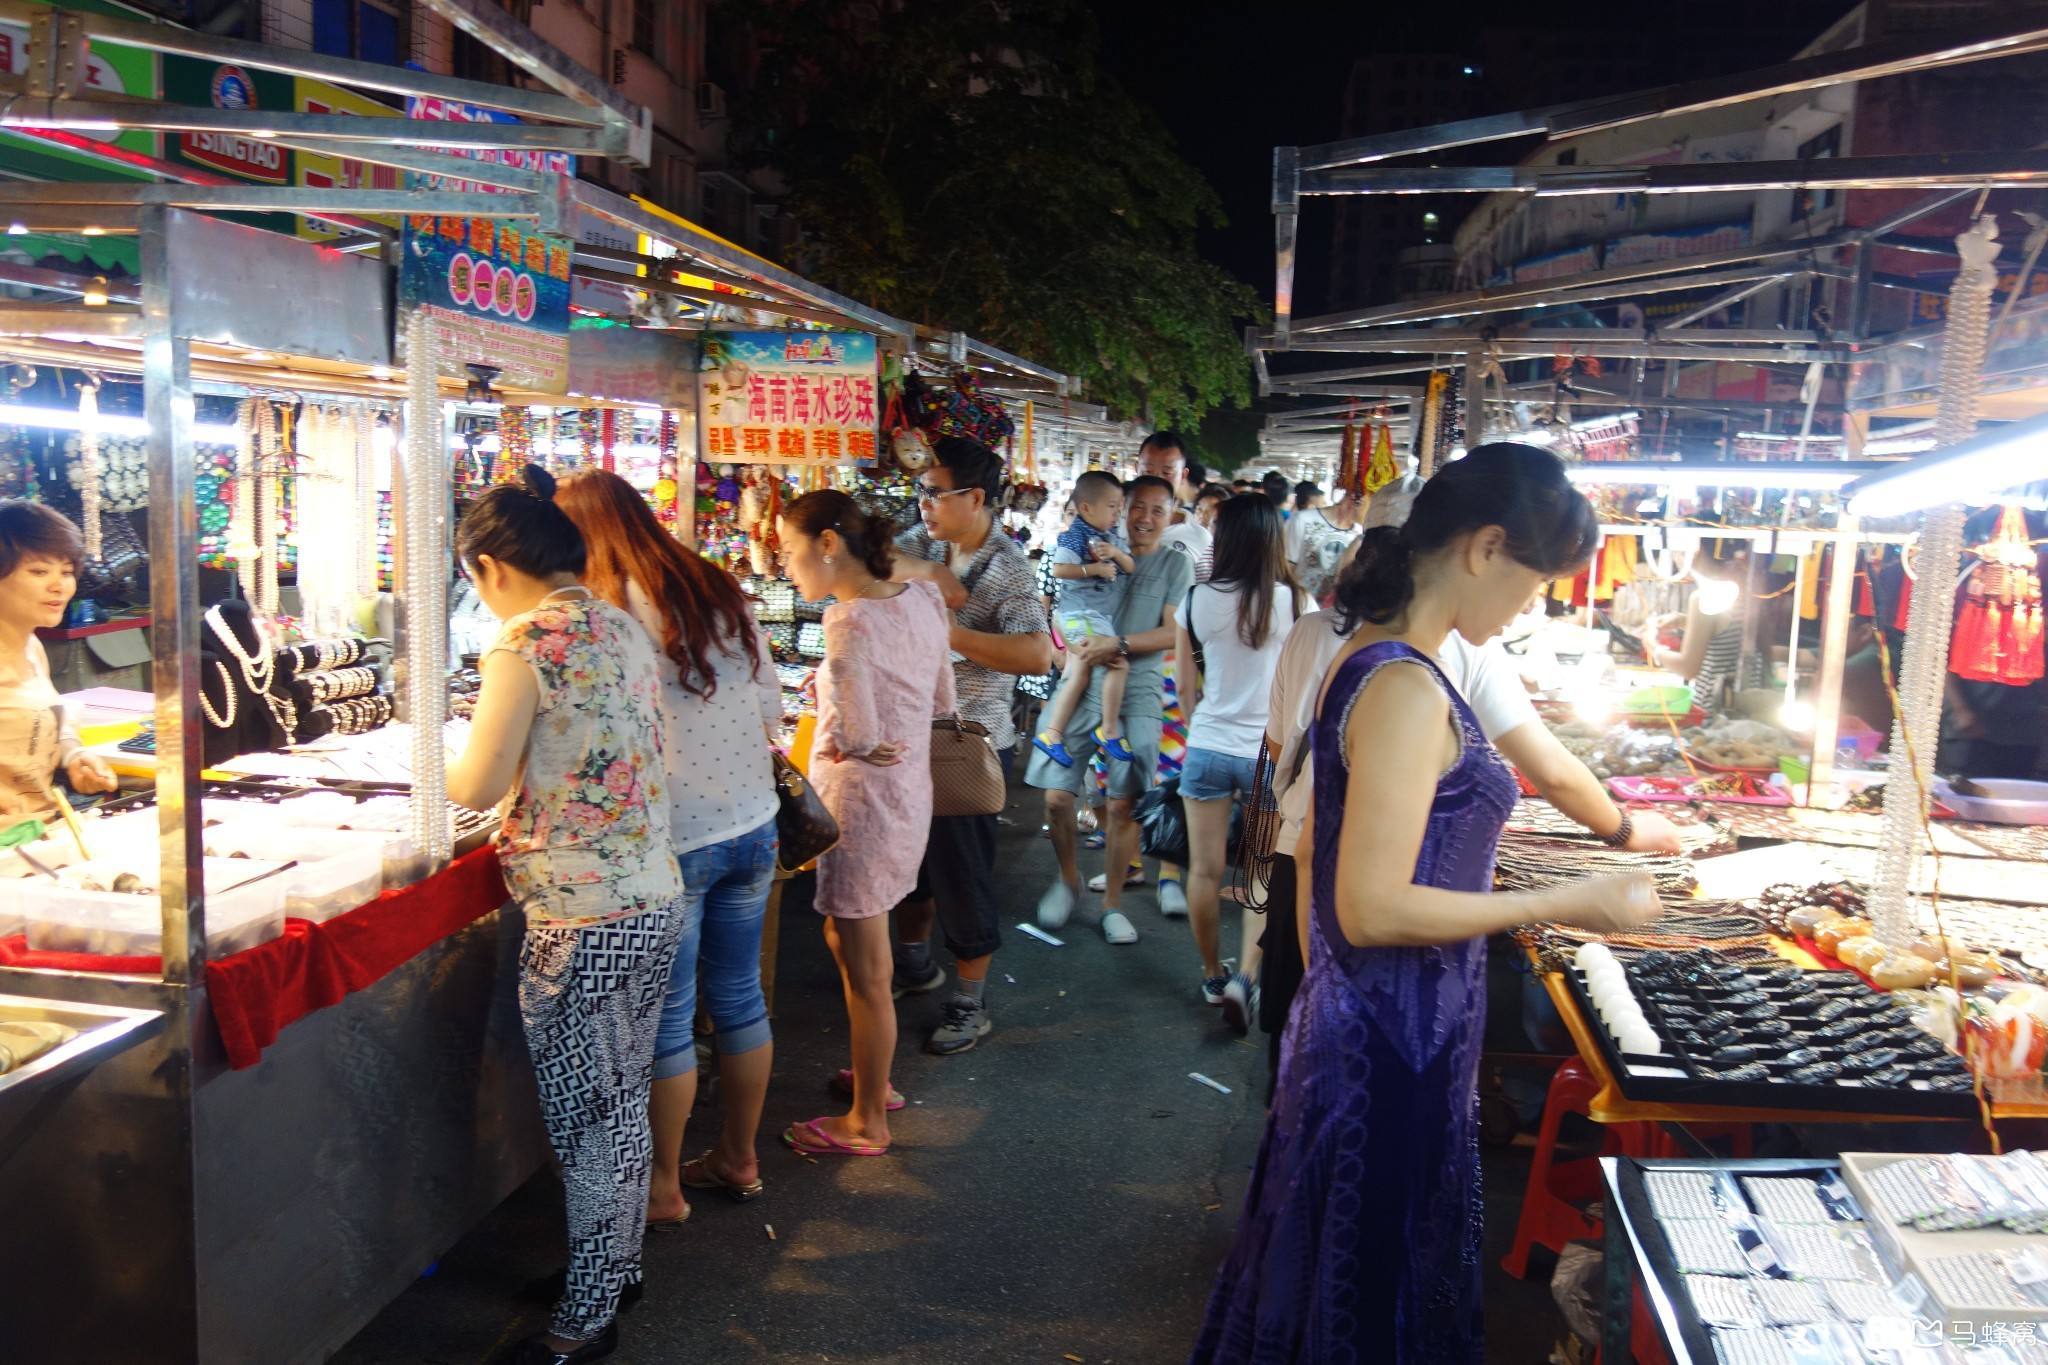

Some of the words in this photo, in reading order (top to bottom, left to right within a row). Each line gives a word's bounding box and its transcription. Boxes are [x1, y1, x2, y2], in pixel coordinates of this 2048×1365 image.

[748, 373, 875, 426] 海南海水珍珠
